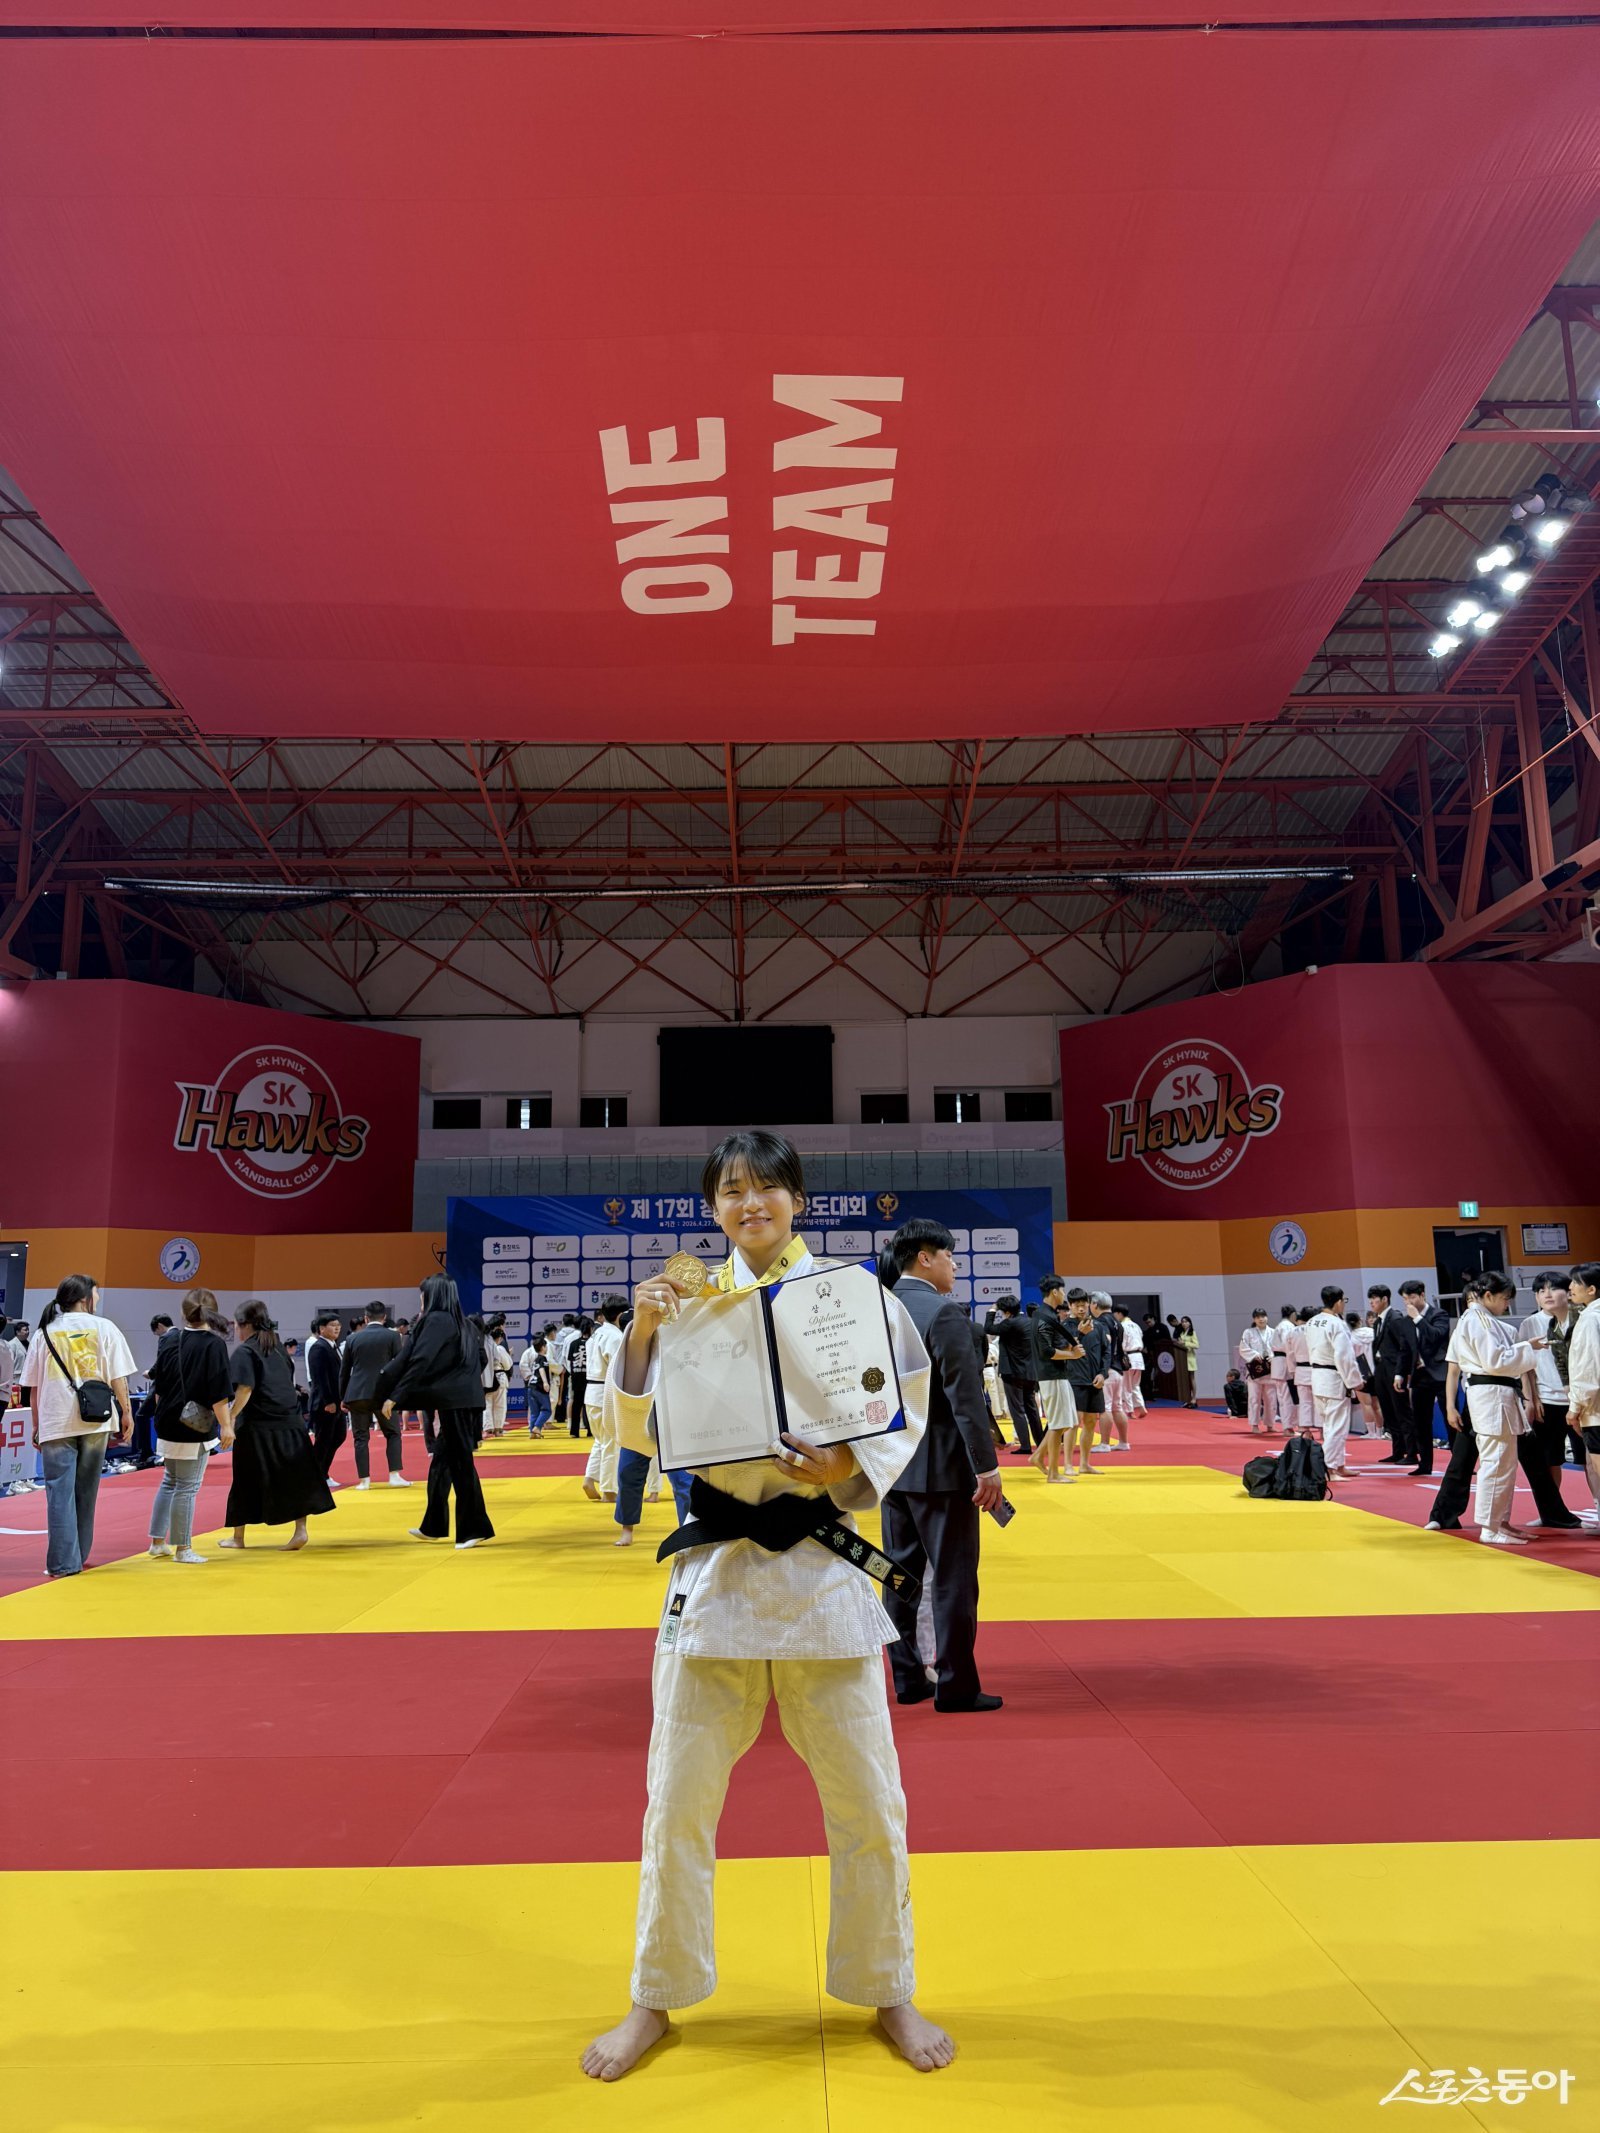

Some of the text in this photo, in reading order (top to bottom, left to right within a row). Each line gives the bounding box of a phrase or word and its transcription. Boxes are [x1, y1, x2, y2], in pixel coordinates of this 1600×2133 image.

[598, 417, 733, 615] ONE
[772, 374, 904, 646] TEAM
[255, 1056, 308, 1075] SK HYNIX
[1162, 1050, 1210, 1069] SK HYNIX
[263, 1080, 296, 1108] SK
[1172, 1073, 1204, 1101] SK
[174, 1081, 371, 1161] Hawks
[1102, 1073, 1284, 1163] Hawks
[234, 1158, 320, 1188] HANDBALL CLUB
[1155, 1147, 1234, 1180] HANDBALL CLUB
[630, 1198, 650, 1219] 제
[655, 1197, 695, 1219] 17회
[808, 1312, 847, 1327] Diploma
